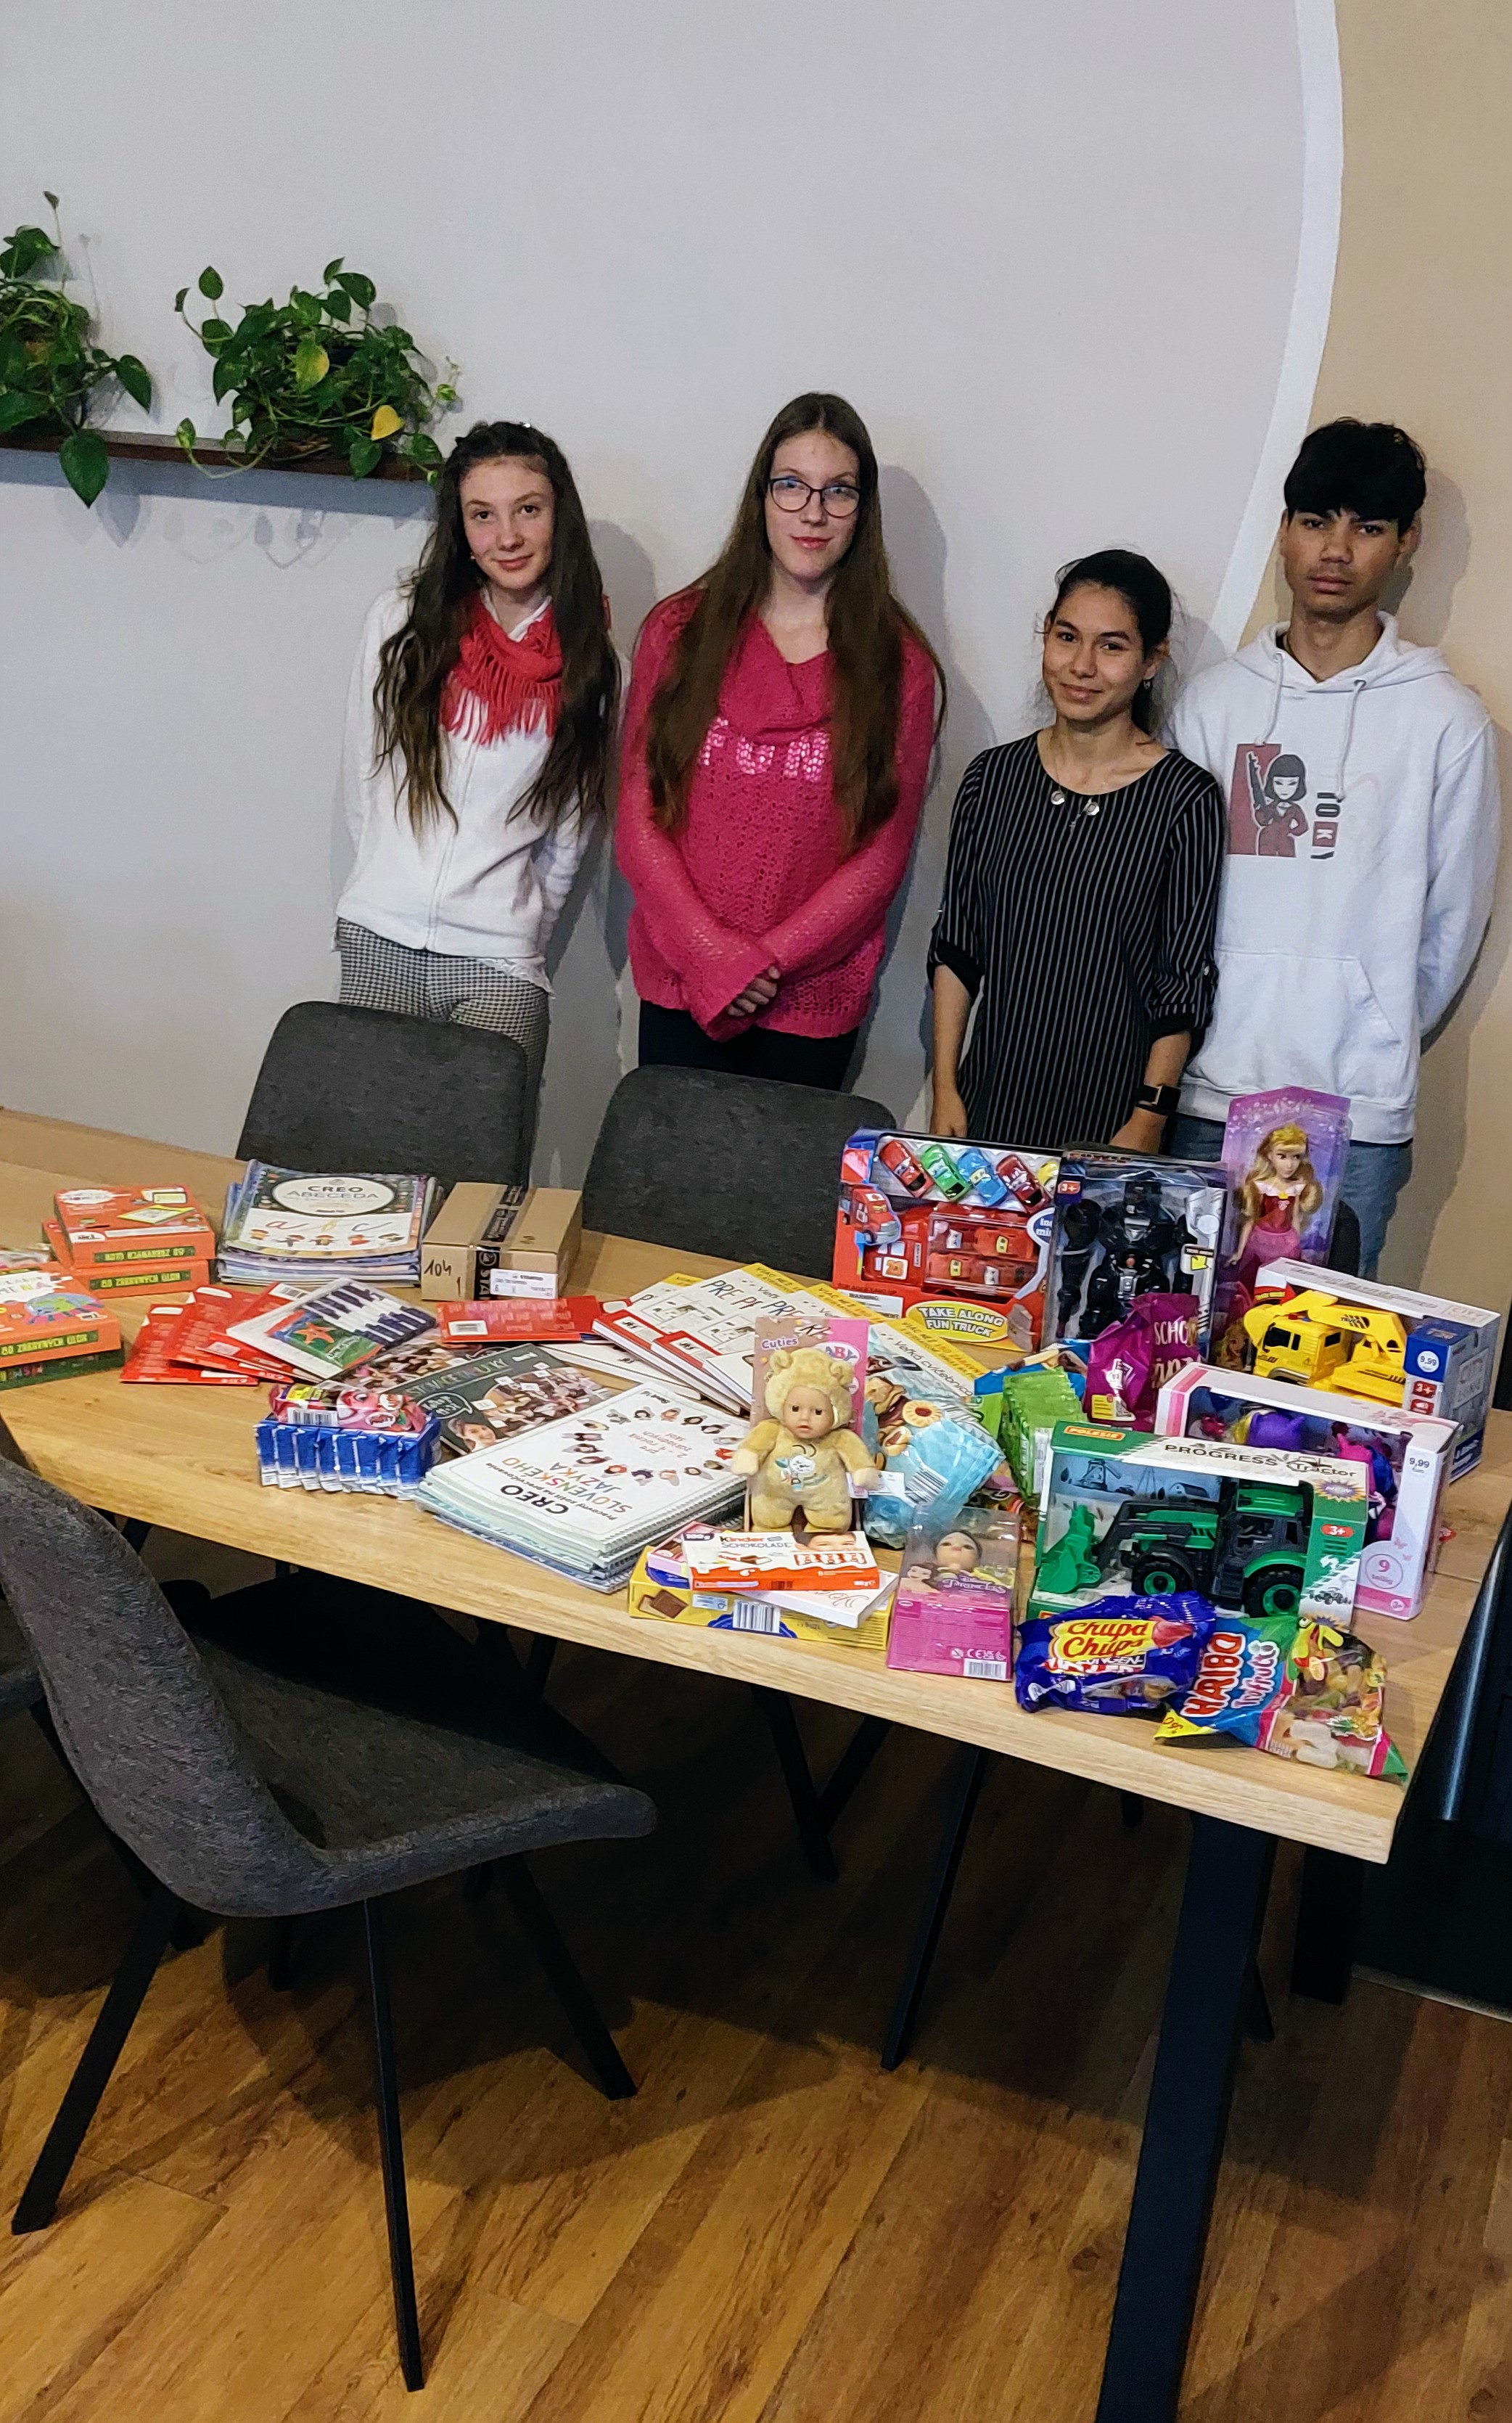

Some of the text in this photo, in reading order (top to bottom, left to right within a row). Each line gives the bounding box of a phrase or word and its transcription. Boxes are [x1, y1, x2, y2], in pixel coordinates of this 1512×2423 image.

[287, 1190, 379, 1199] ABECEDA
[424, 1259, 452, 1277] 104
[700, 1279, 744, 1300] PRE
[918, 1307, 956, 1318] TAKE
[958, 1308, 1005, 1327] ALONG
[925, 1319, 997, 1337] FUN TRUCK
[762, 1337, 798, 1350] Cuties
[826, 1346, 858, 1361] ABY
[1164, 1444, 1357, 1478] PROGRESS Tractor
[1409, 1457, 1430, 1469] 9,99
[501, 1457, 633, 1514] SLOVENSKÉHO
[549, 1461, 622, 1493] JAZYKA
[500, 1485, 569, 1514] CREO
[1328, 1525, 1346, 1535] 3+
[1379, 1559, 1391, 1573] 9
[1067, 1621, 1149, 1643] Chupa
[1062, 1635, 1146, 1658] Chups
[1182, 1632, 1245, 1717] HARIBO
